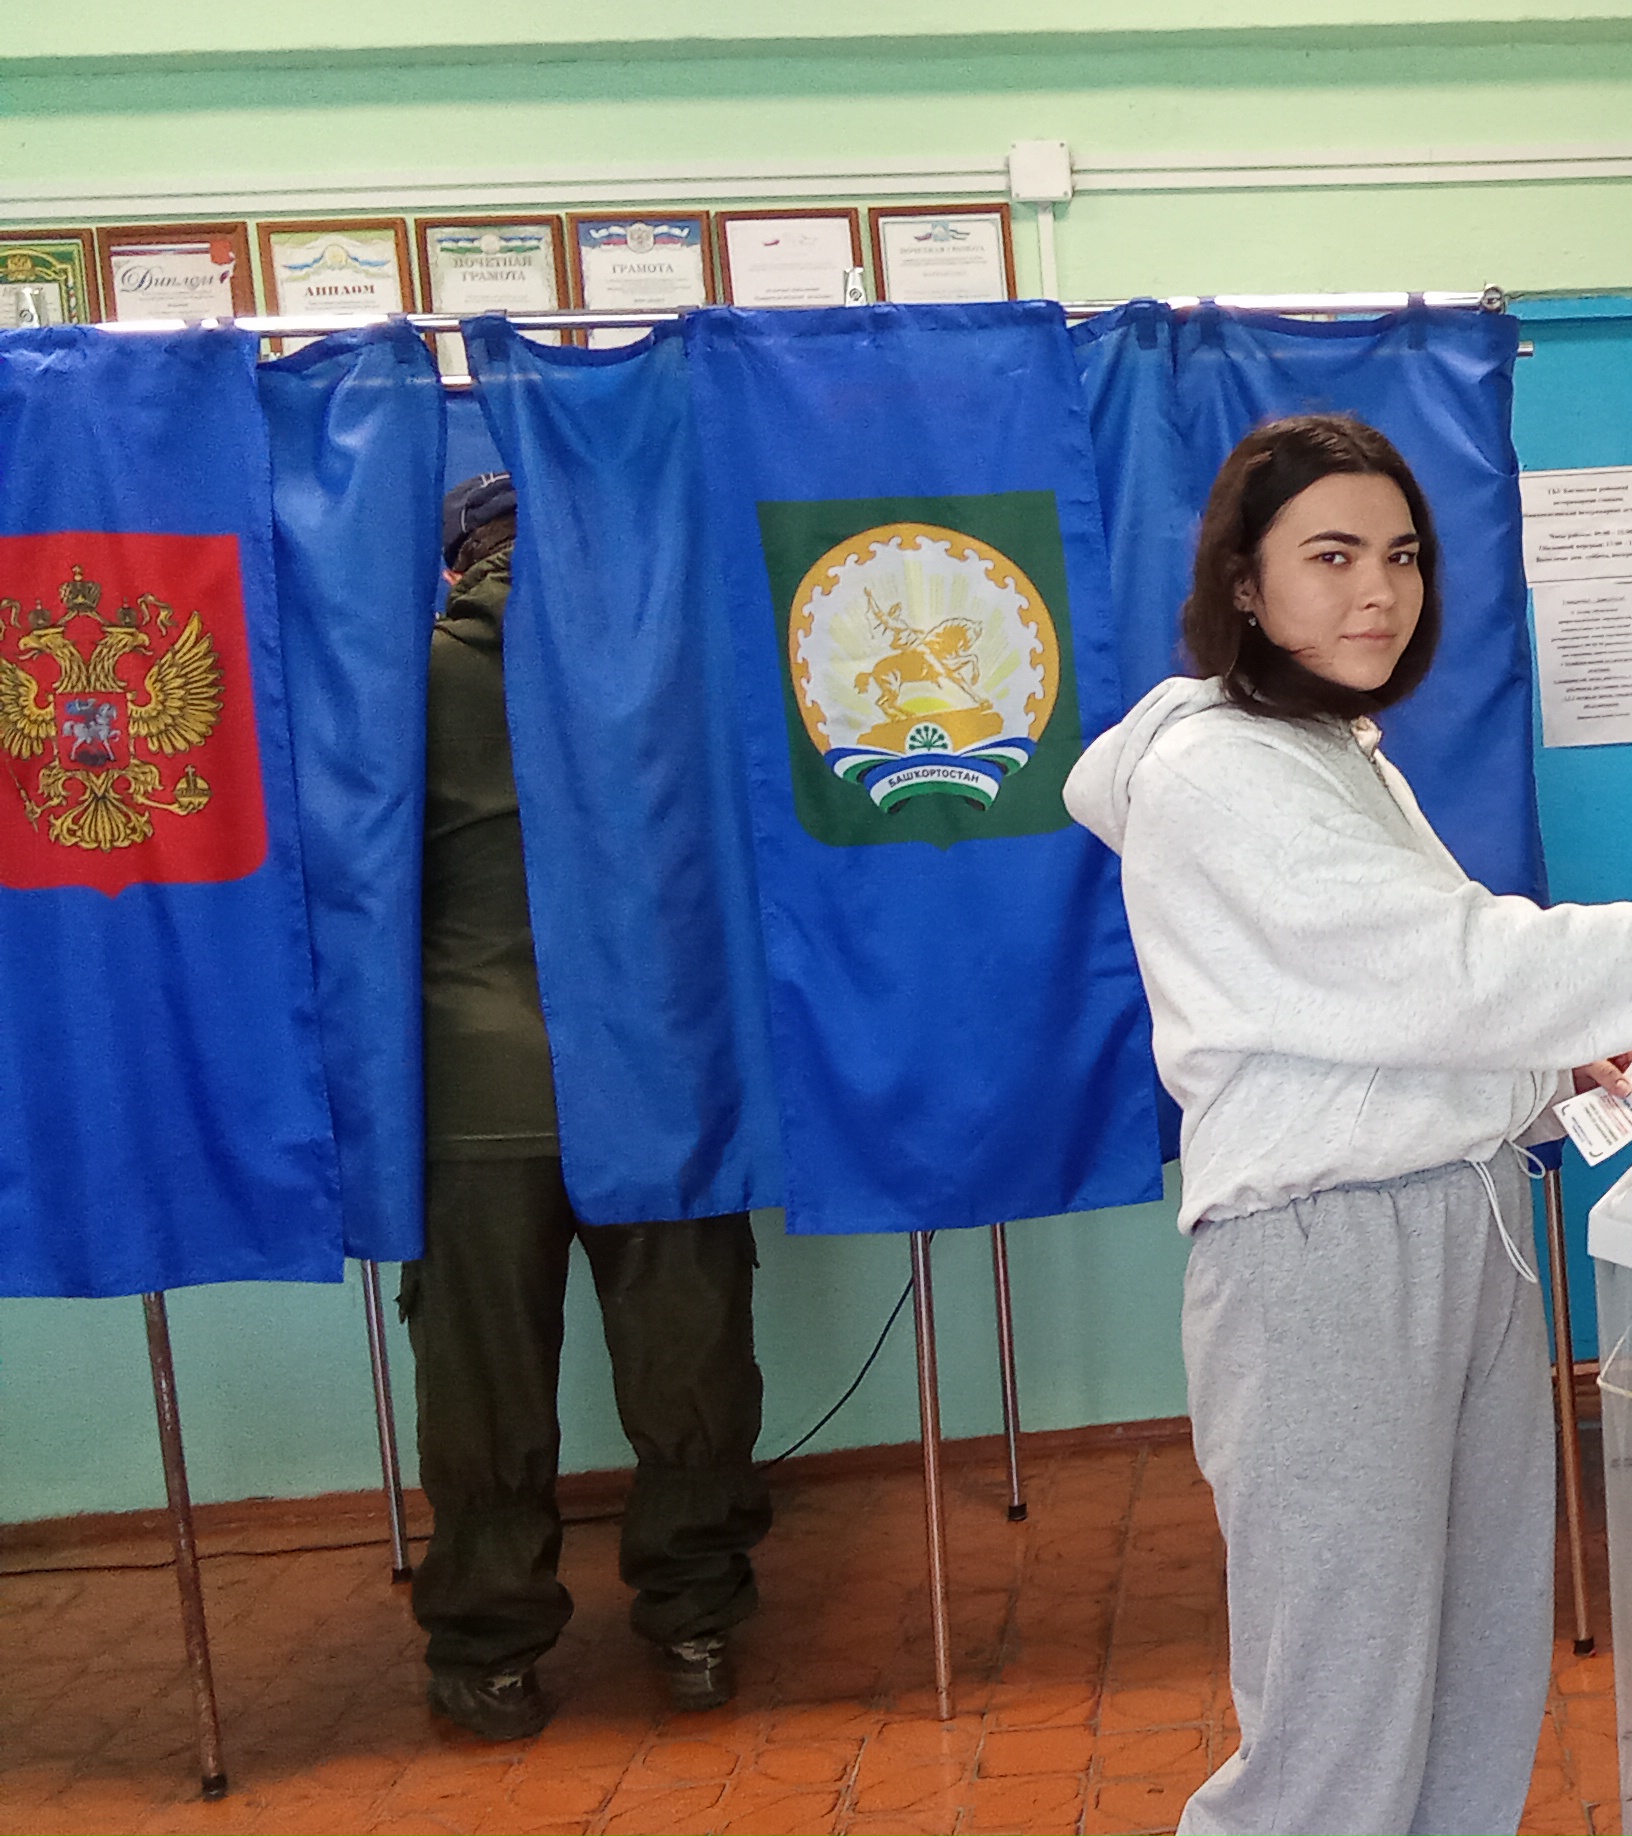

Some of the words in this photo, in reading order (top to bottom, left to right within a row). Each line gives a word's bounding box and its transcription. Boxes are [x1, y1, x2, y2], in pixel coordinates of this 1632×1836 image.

[611, 262, 675, 275] ГРАМОТА
[461, 269, 526, 282] ГРАМОТА
[304, 284, 375, 297] ДИПЛОМ
[887, 768, 979, 788] БАШКОРТОСТАН
